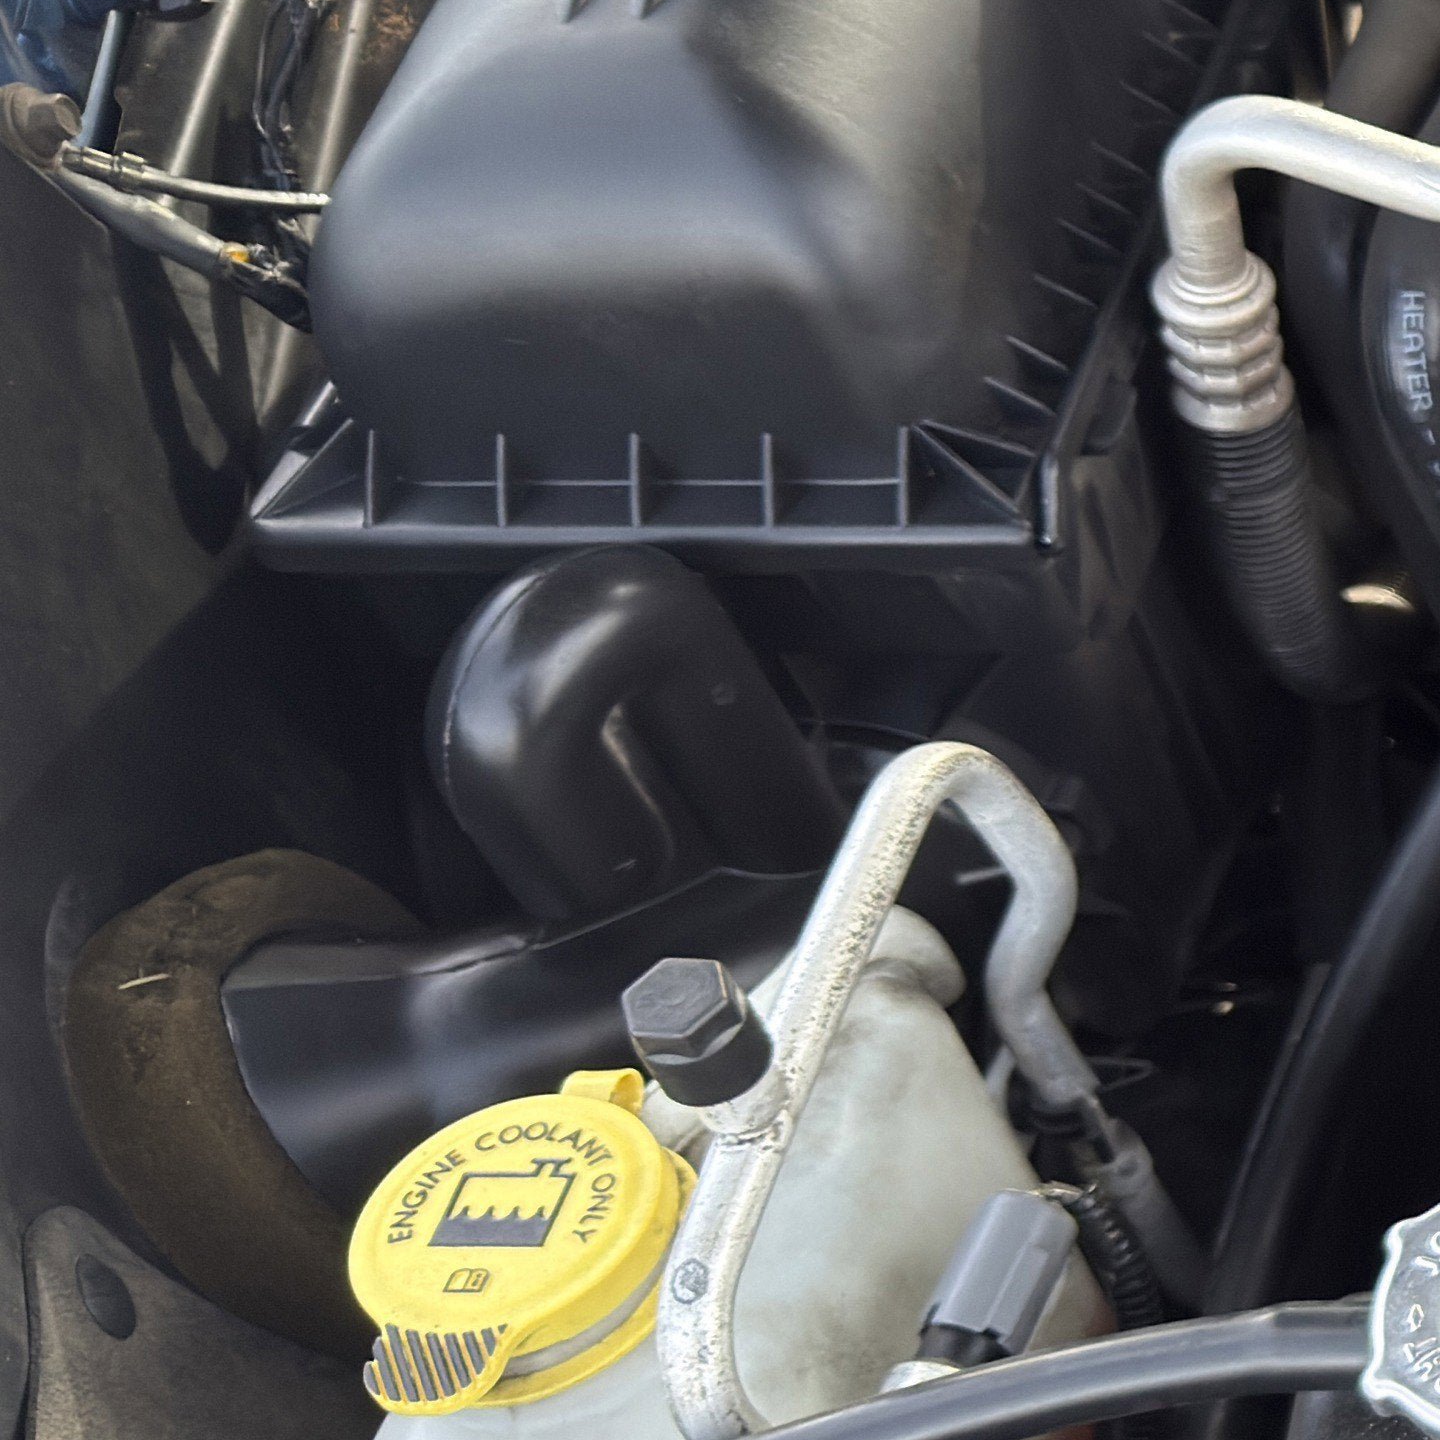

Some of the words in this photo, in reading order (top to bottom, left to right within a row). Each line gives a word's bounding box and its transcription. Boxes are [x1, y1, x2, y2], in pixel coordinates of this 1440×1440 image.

[1400, 290, 1433, 411] HEATER
[387, 1148, 463, 1246] ENGINE
[474, 1121, 614, 1169] COOLANT
[570, 1172, 618, 1245] ONLY
